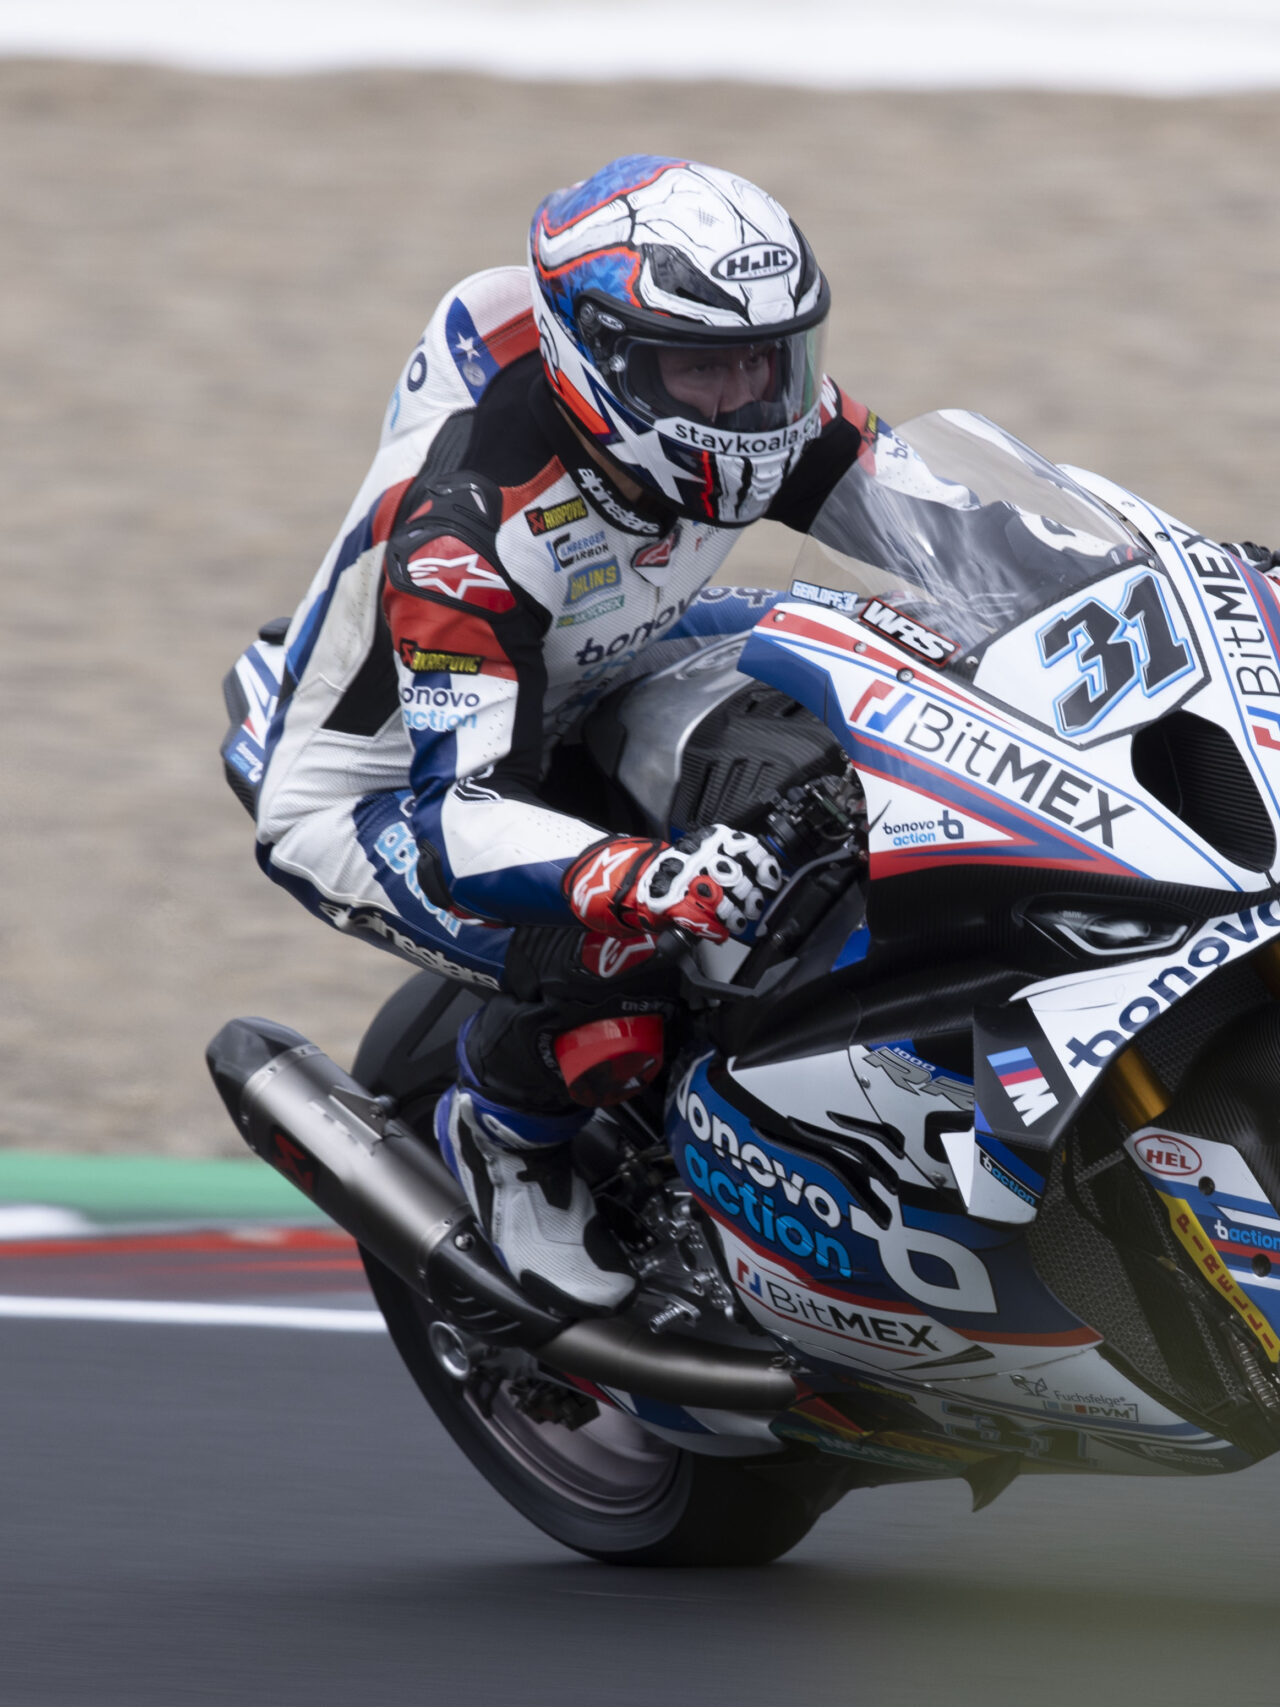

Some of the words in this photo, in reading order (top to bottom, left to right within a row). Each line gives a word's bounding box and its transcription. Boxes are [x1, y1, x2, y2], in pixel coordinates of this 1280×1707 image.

[727, 250, 788, 277] HJC
[578, 467, 660, 535] alpinestars
[862, 600, 956, 660] WRS
[1037, 575, 1194, 734] 31
[402, 686, 480, 708] onovo
[904, 703, 1136, 850] BitMEX
[882, 820, 935, 835] bonovo
[892, 832, 936, 846] action
[893, 1047, 937, 1073] 1000
[1146, 1149, 1192, 1170] HEL
[685, 1144, 852, 1279] action
[1176, 1213, 1275, 1350] PIRELLI
[766, 1281, 942, 1352] BitMEX
[1088, 1405, 1130, 1419] PVM
